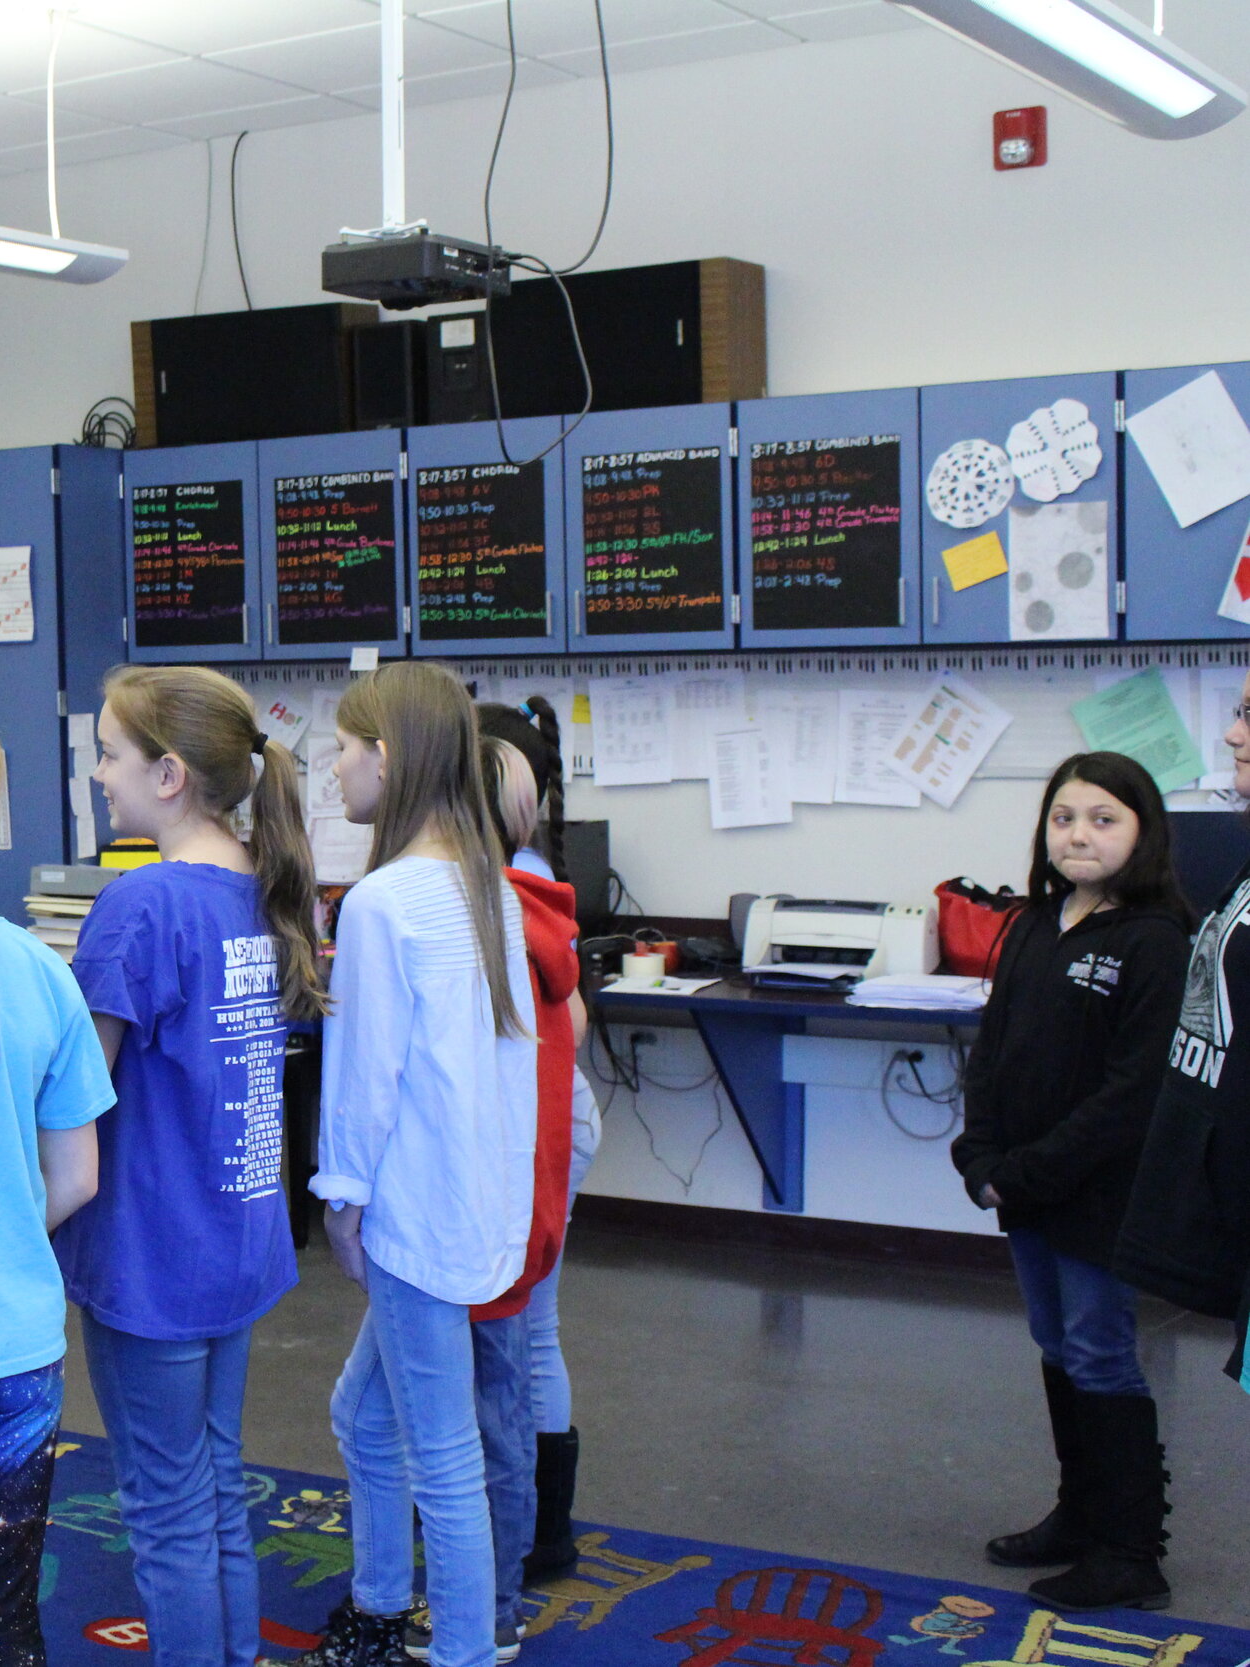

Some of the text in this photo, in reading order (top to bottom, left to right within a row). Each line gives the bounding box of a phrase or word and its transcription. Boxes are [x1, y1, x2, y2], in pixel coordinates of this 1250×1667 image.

[752, 440, 812, 460] 8:17-8:57
[814, 436, 870, 452] COMBINED
[636, 449, 686, 464] ADVANCED
[277, 476, 319, 492] 8:17-8:57
[320, 471, 371, 488] COMBINED
[418, 467, 468, 486] 8:17-8:57
[176, 485, 216, 498] CHORUS
[322, 488, 346, 500] Prep
[471, 501, 495, 514] Prep
[325, 519, 358, 532] Lunch
[176, 530, 204, 542] Lunch
[813, 531, 847, 546] Lunch
[475, 563, 506, 576] Lunch
[587, 565, 679, 583] 1:26-2:06 Lunch
[813, 573, 843, 589] Prep
[472, 591, 496, 604] Prep
[1168, 1026, 1226, 1089] SON
